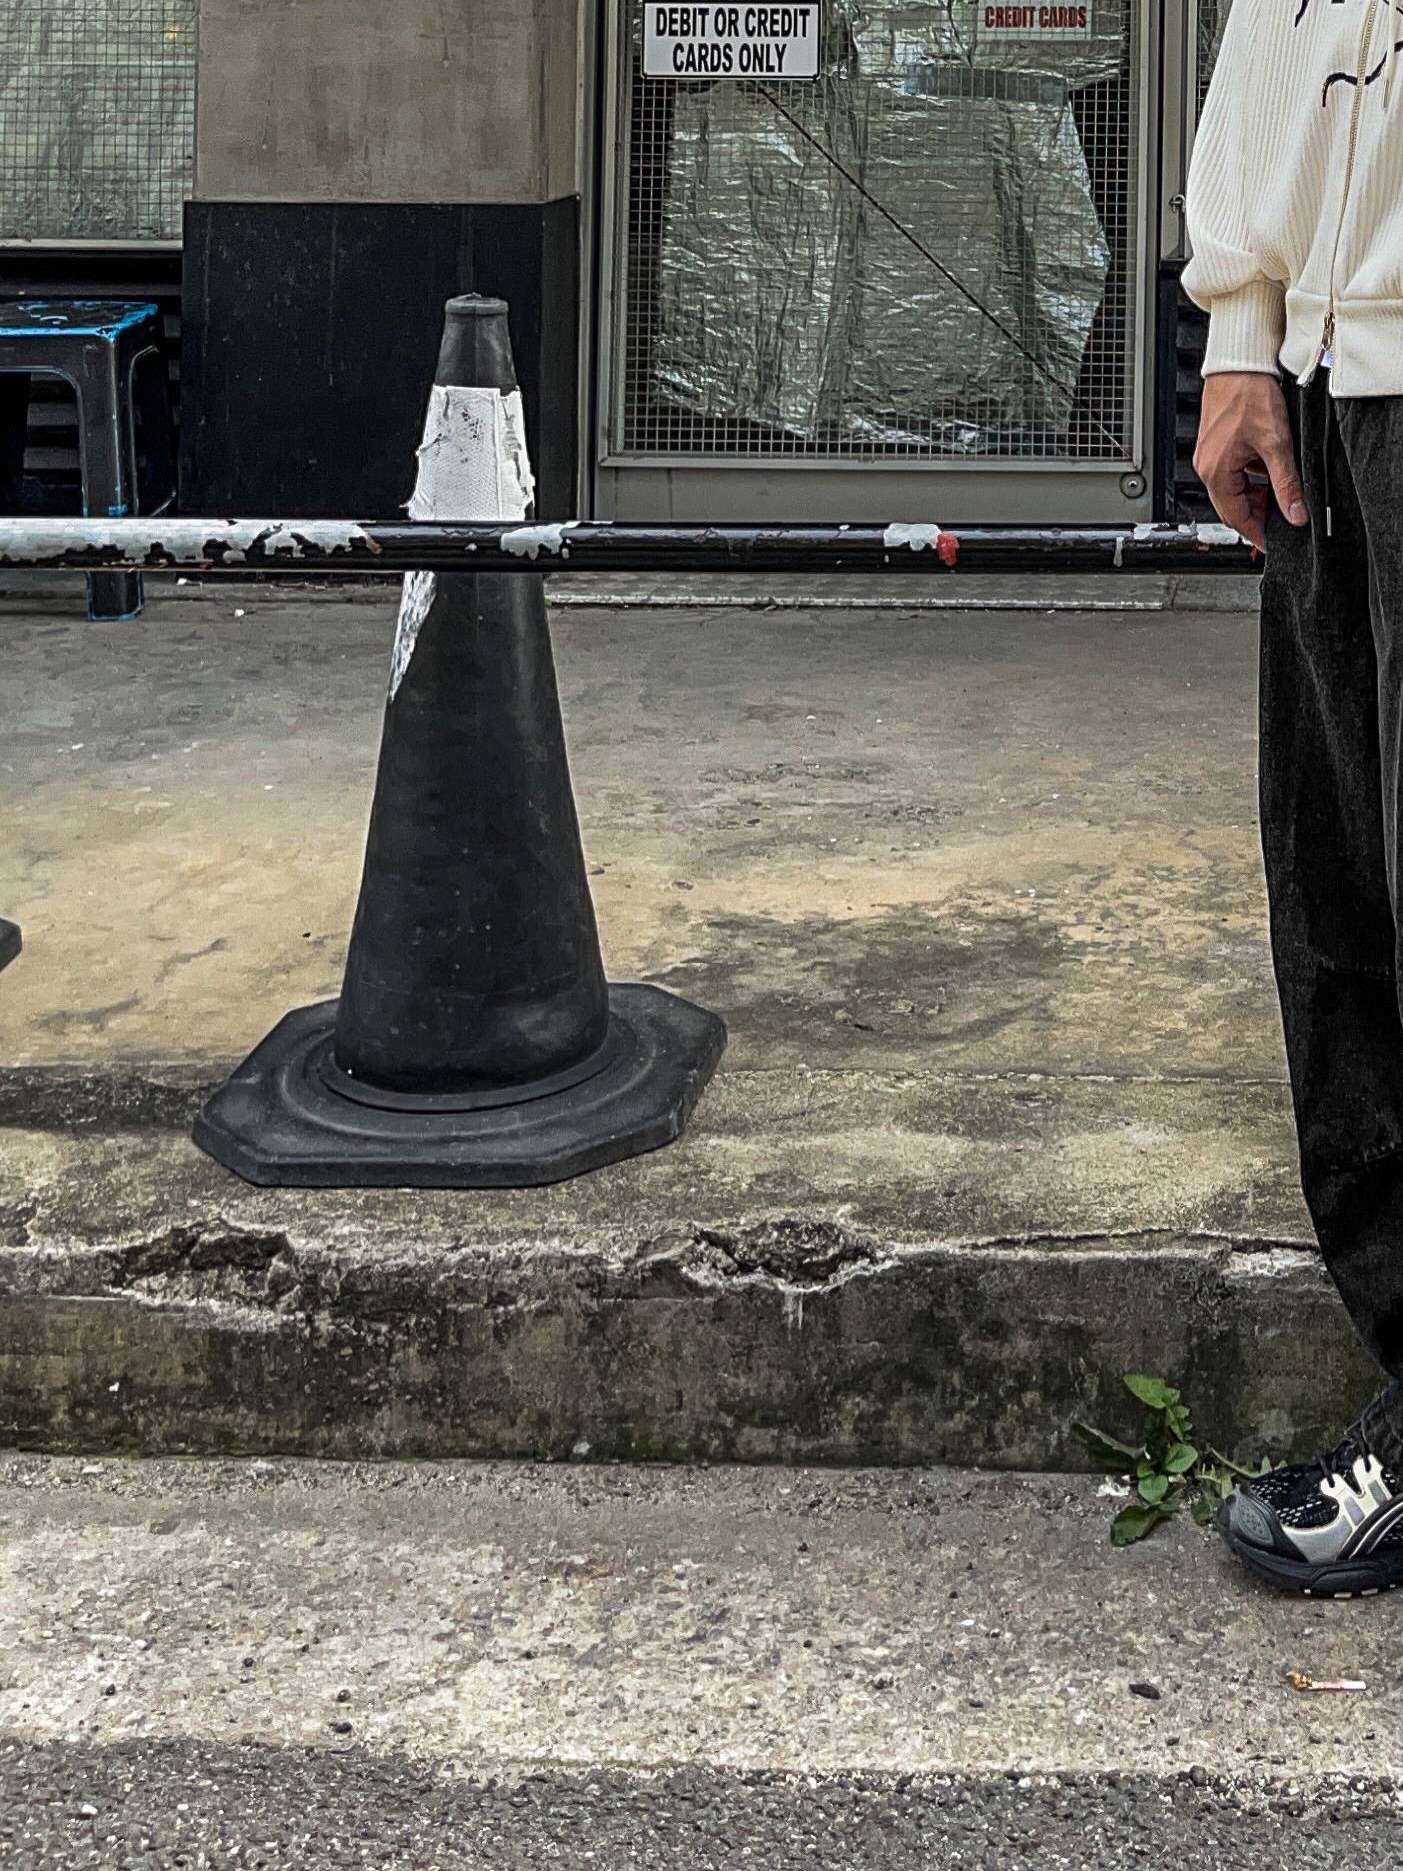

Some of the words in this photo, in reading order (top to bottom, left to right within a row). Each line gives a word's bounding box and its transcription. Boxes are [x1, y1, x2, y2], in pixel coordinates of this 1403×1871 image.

[656, 7, 710, 37] DEBIT
[714, 7, 739, 37] OR
[745, 8, 811, 38] CREDIT
[985, 6, 1036, 28] CREDIT
[1039, 6, 1087, 28] CARDS
[672, 43, 734, 73] CARDS
[739, 43, 788, 73] ONLY
